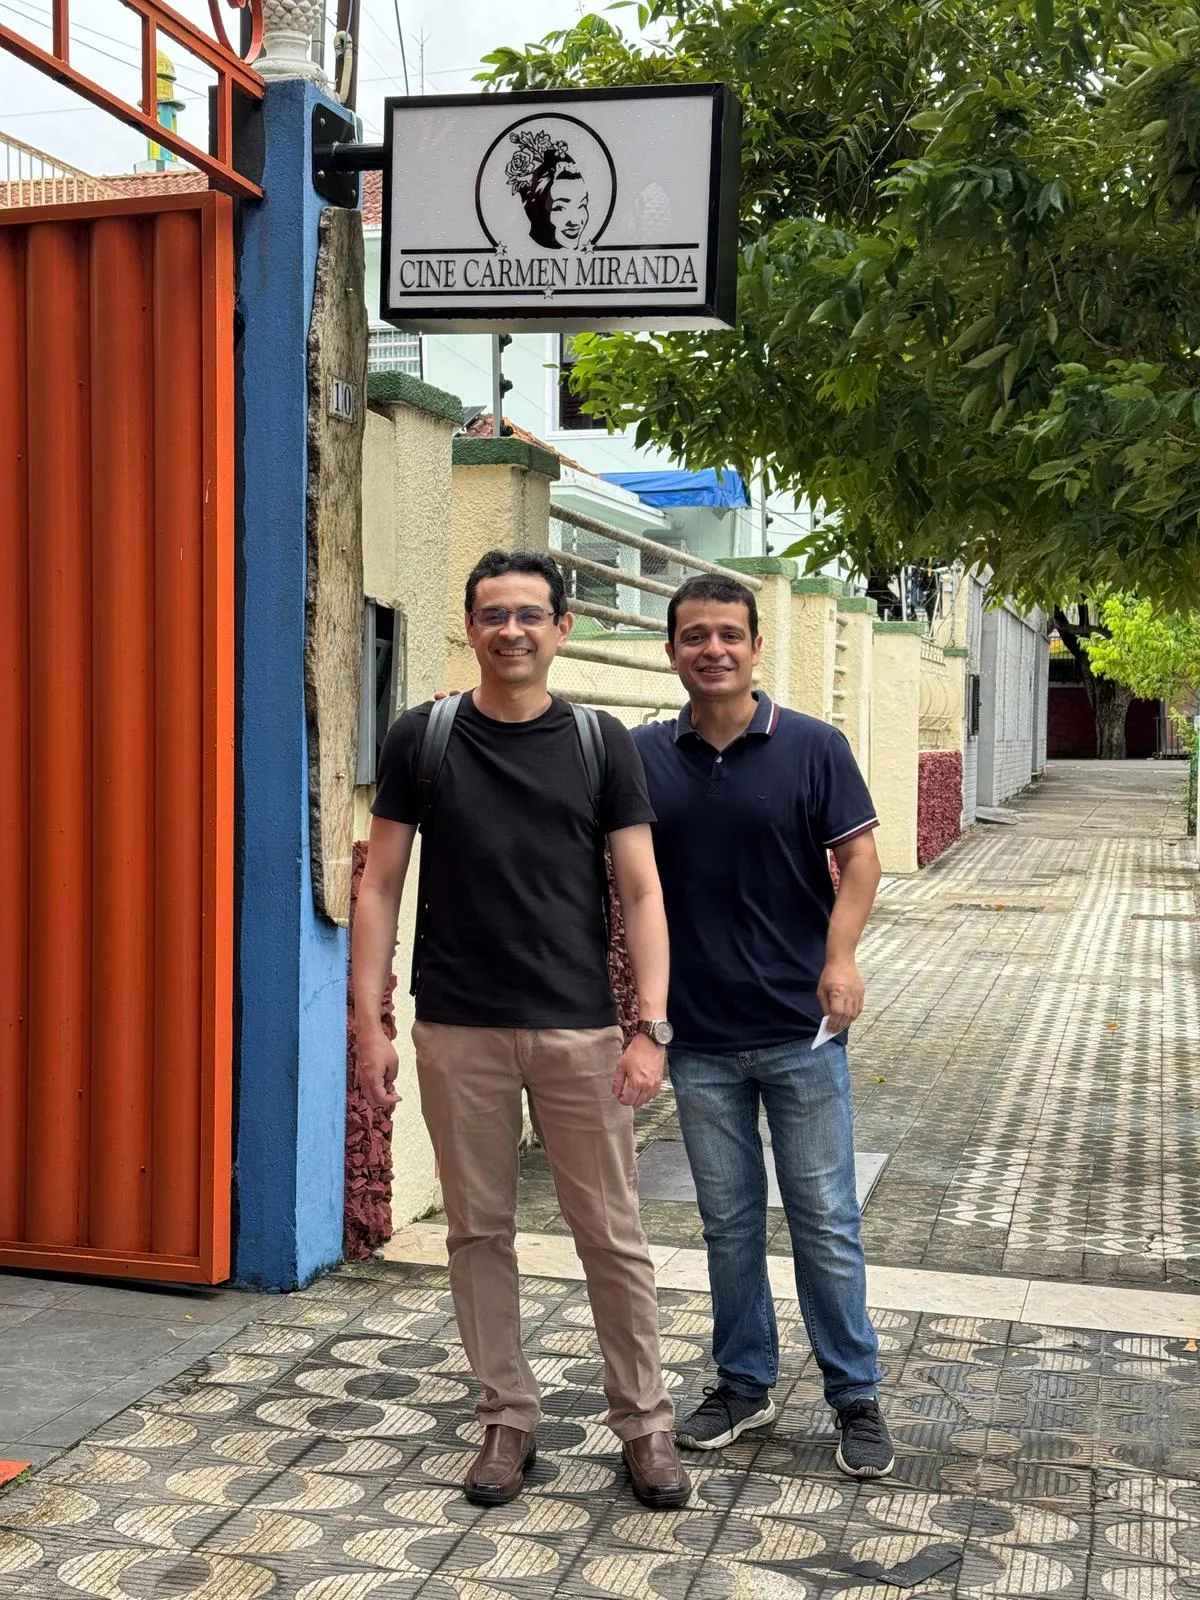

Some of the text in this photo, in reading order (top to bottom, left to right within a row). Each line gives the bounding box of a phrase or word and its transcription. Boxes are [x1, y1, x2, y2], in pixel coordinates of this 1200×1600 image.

[400, 255, 698, 289] CINE CARMEN MIRANDA
[335, 382, 351, 416] 10
